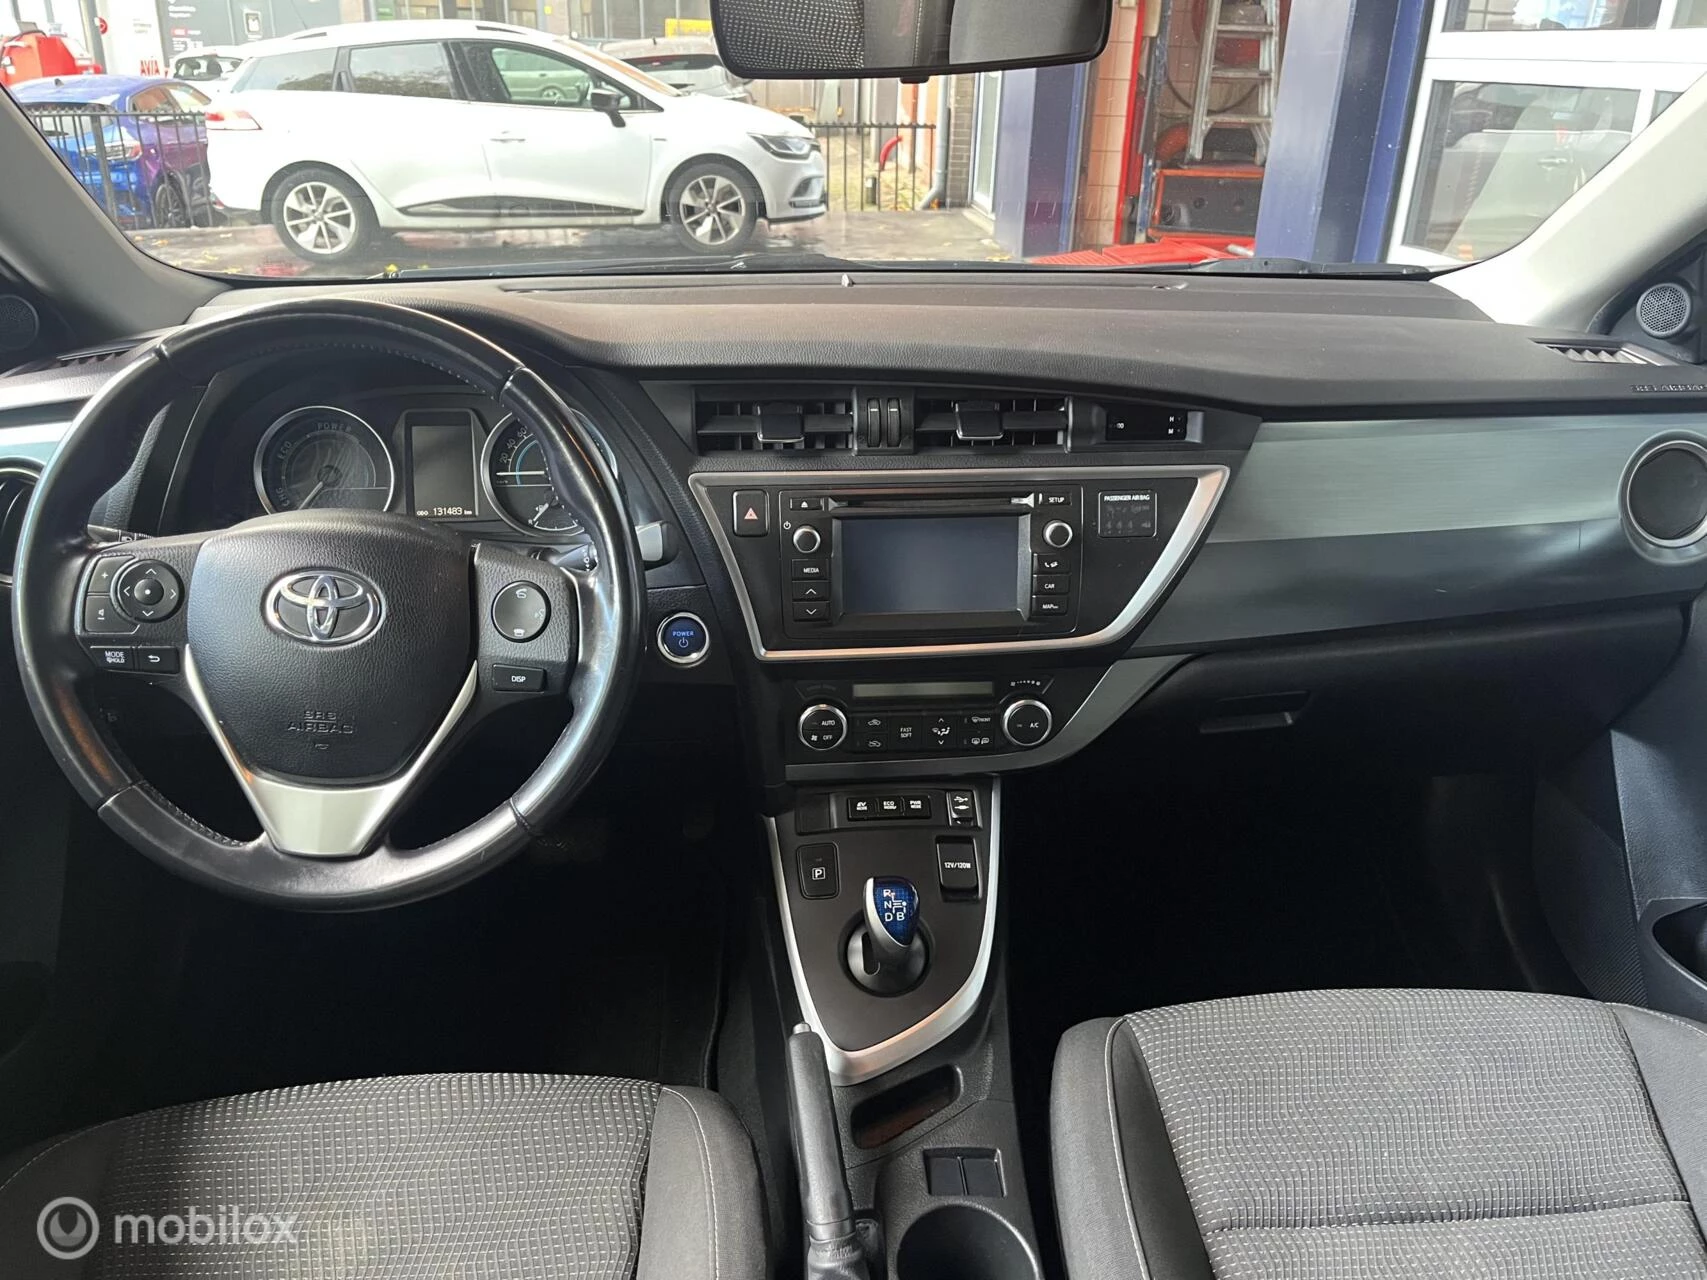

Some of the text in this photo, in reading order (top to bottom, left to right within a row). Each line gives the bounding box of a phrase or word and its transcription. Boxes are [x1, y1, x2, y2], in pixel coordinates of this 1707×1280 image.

[140, 60, 160, 76] AVIA
[317, 422, 352, 432] POWER
[433, 507, 463, 516] 131483
[883, 889, 891, 897] R
[884, 900, 892, 909] N
[885, 912, 905, 922] D B
